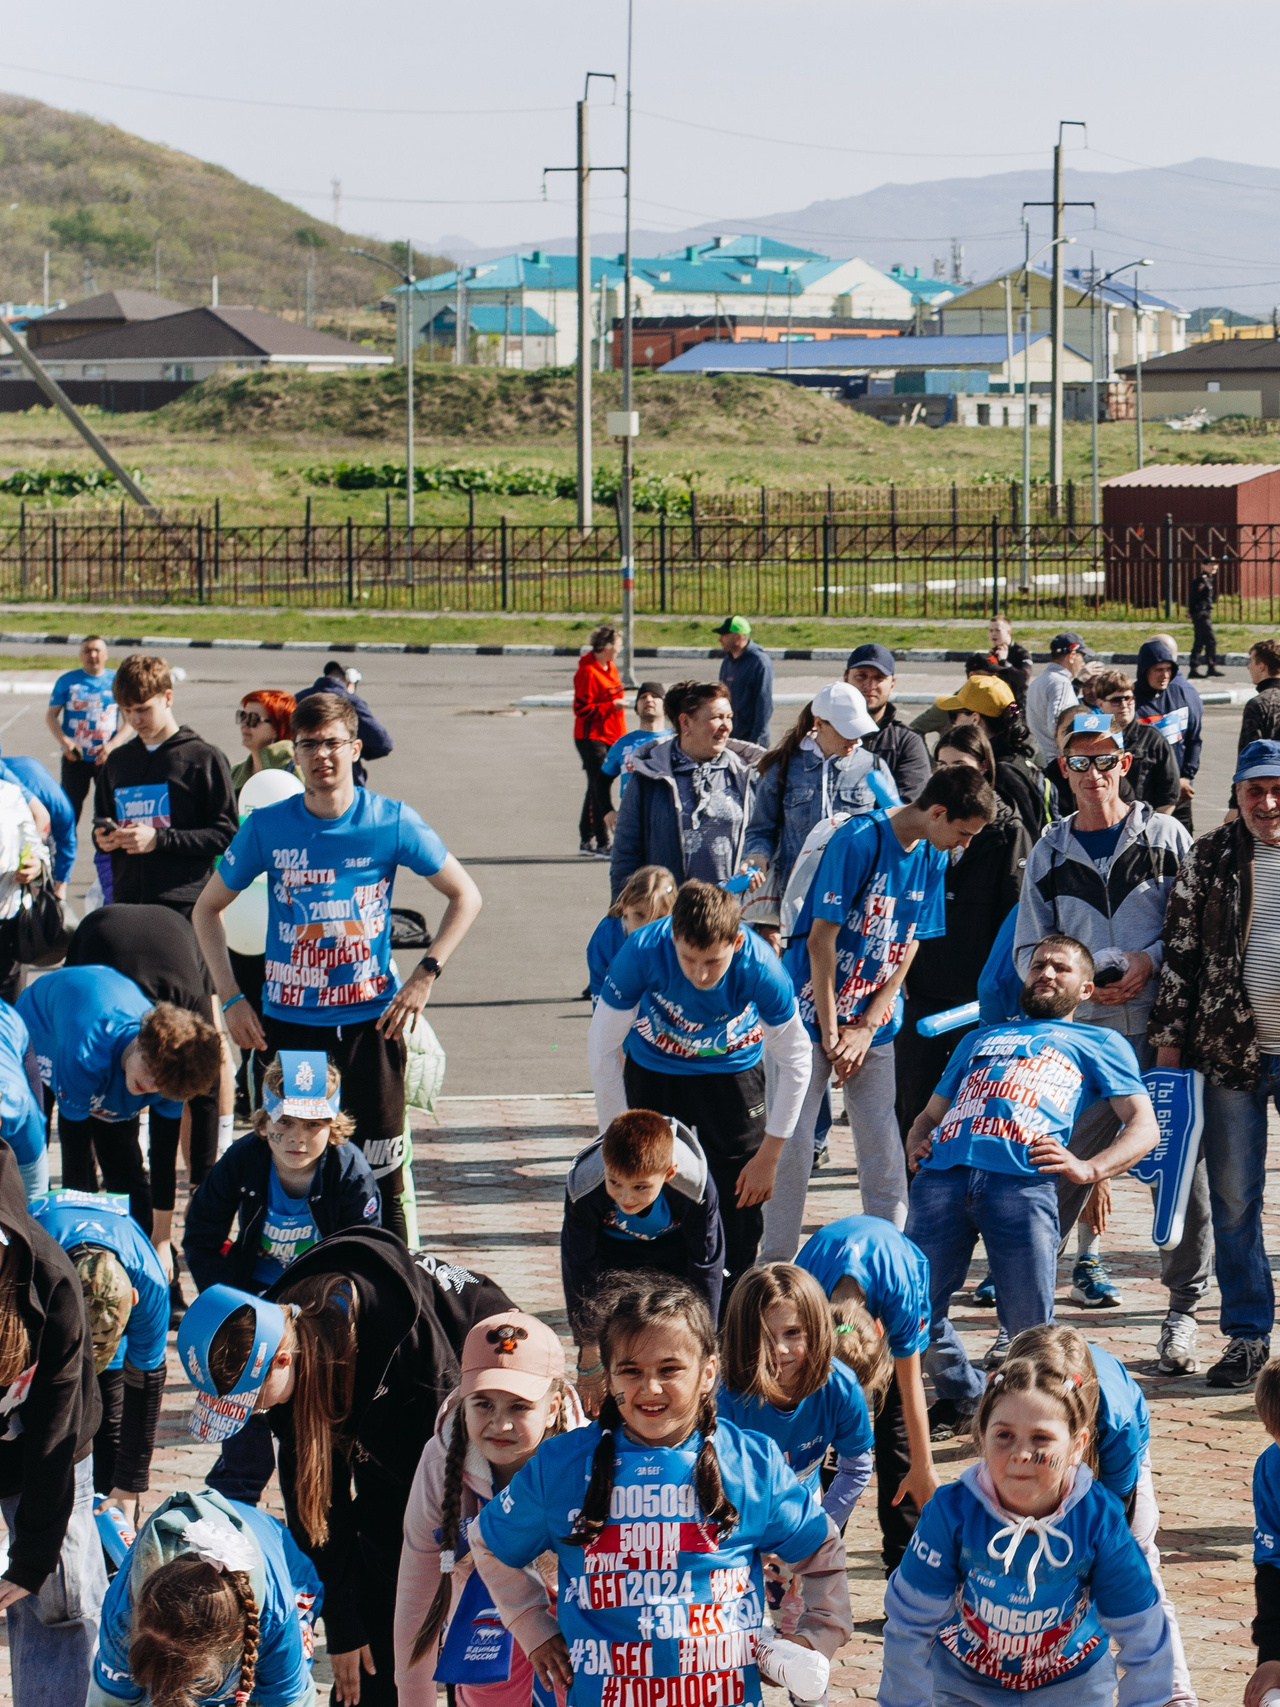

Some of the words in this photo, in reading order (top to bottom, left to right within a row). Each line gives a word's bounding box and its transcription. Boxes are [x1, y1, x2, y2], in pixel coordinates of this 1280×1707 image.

[273, 848, 309, 869] 2024
[282, 869, 336, 887] #МЕЧТА
[309, 900, 350, 920] 20007
[266, 960, 329, 988] #ЛЮБОВЬ
[955, 1080, 1038, 1110] #ГОРДОСТЬ
[1158, 1081, 1175, 1103] ТЫ
[1011, 1103, 1051, 1134] 2024
[364, 1135, 403, 1165] NIKE
[264, 1221, 313, 1243] 10008
[610, 1484, 695, 1520] 00509
[980, 1597, 1059, 1634] 00502
[463, 1652, 499, 1661] РОССИЯ
[569, 1639, 653, 1677] #ЗАБЕГ
[601, 1669, 745, 1707] #ГОРДОСТЬ
